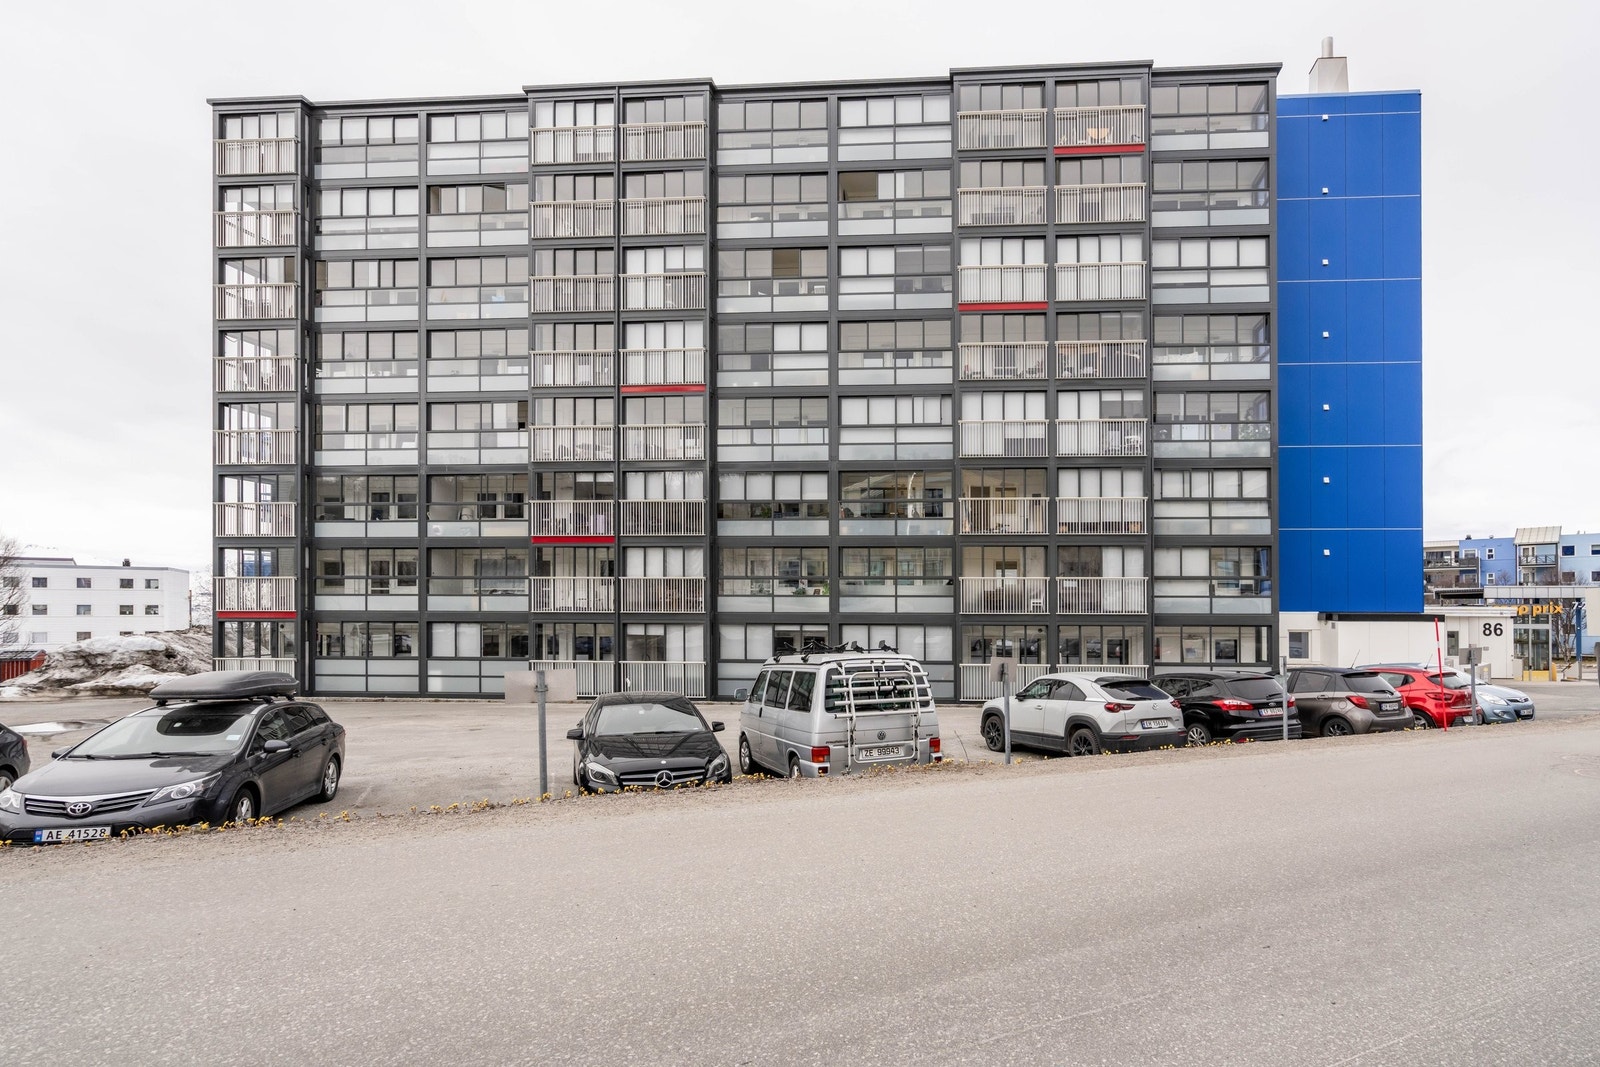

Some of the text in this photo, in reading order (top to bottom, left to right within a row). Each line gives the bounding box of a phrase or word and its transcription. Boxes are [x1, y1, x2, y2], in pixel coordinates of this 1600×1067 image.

[1532, 601, 1564, 617] prix
[1482, 622, 1504, 637] 86
[864, 749, 874, 757] ZE
[46, 828, 107, 840] AE 41528
